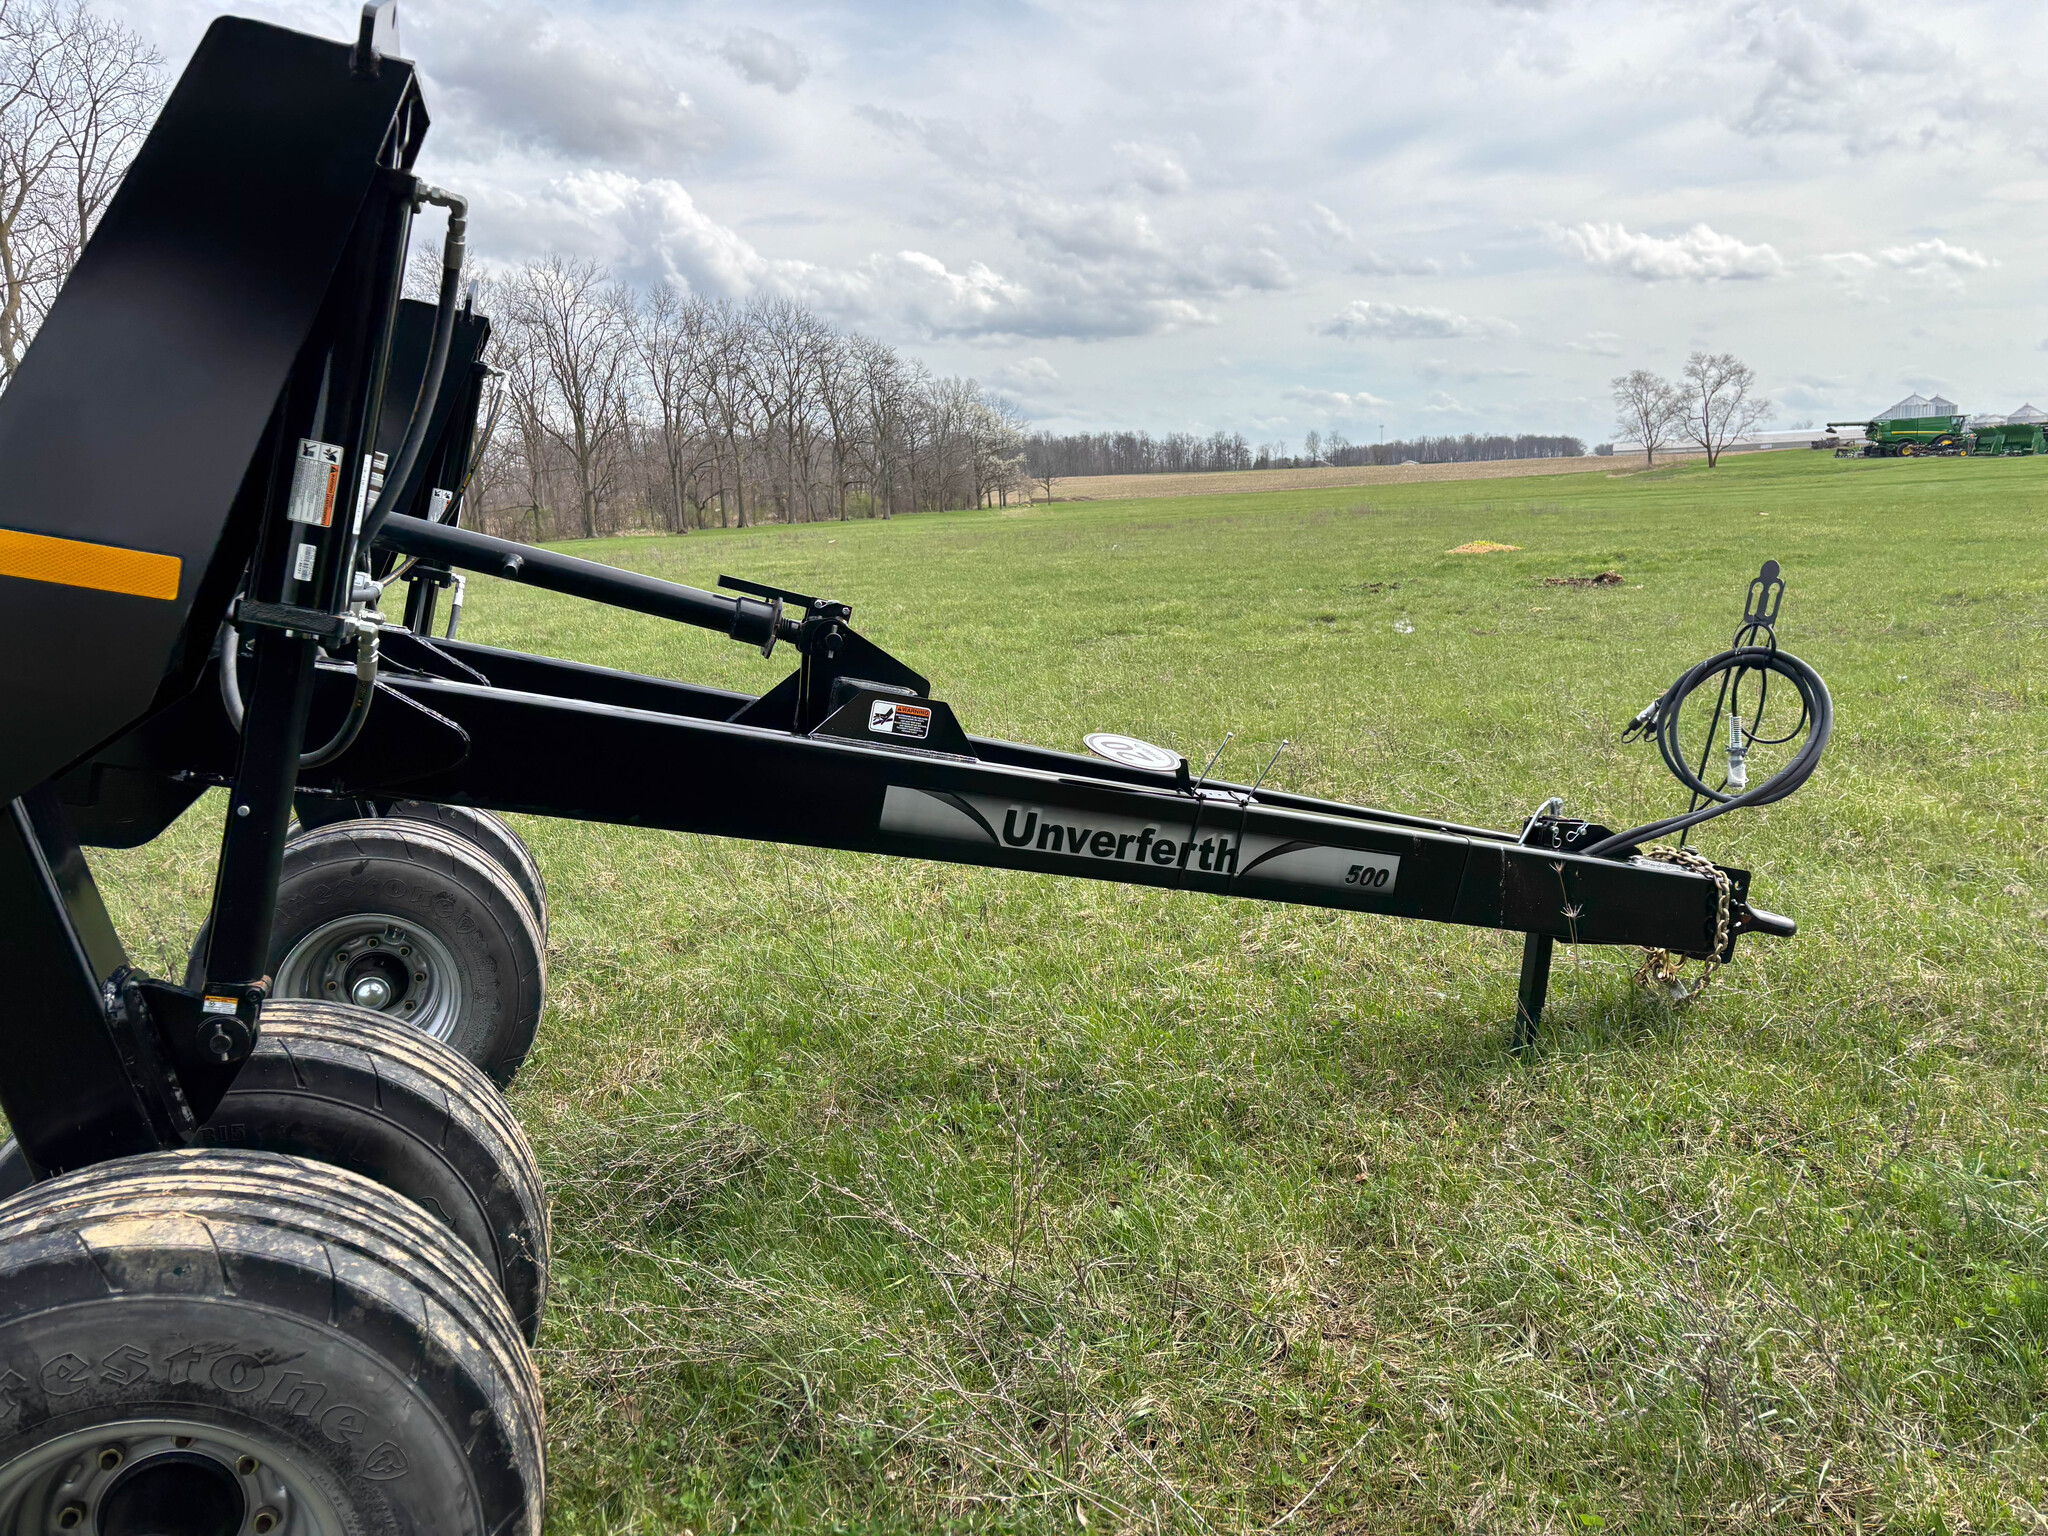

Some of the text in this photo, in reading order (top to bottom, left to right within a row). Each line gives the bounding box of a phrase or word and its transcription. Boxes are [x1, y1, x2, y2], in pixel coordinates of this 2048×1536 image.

[902, 706, 929, 716] WARNING
[1002, 808, 1240, 874] Unverferth
[1345, 864, 1390, 888] 500
